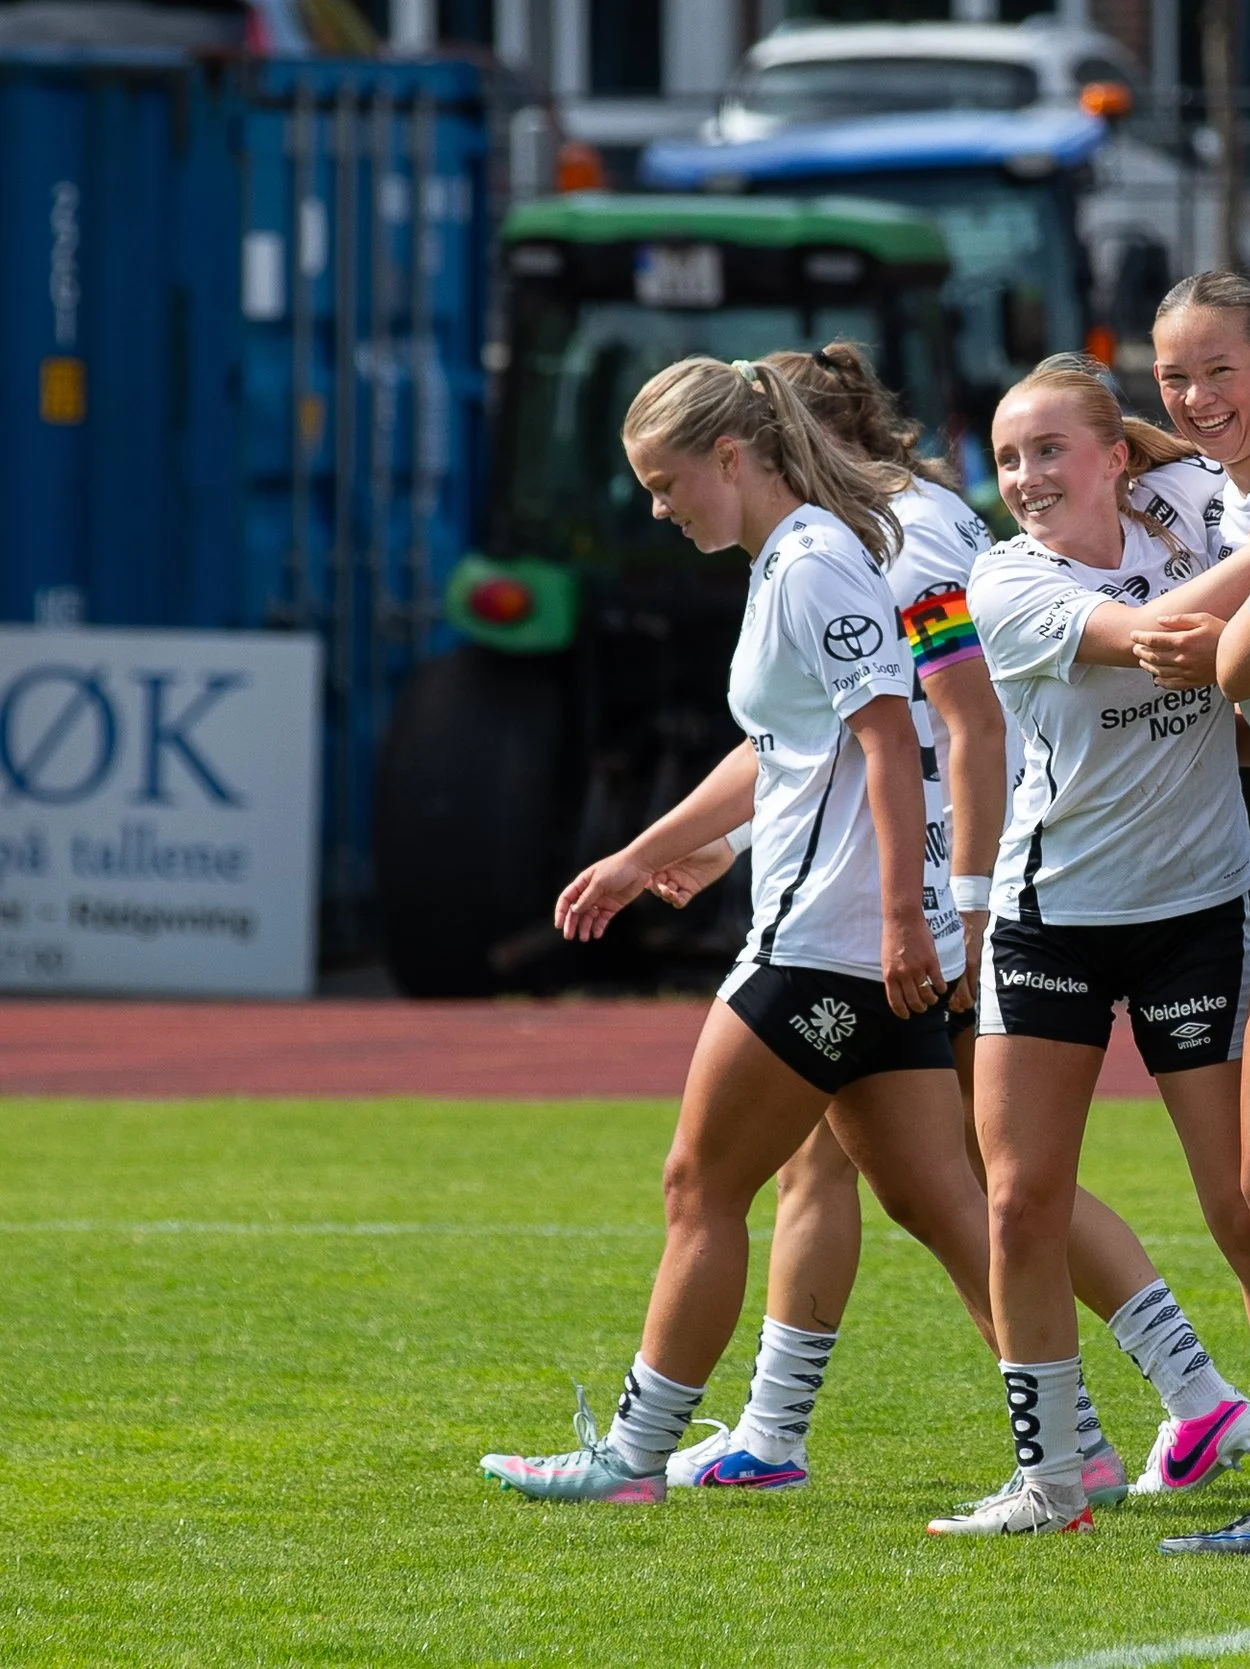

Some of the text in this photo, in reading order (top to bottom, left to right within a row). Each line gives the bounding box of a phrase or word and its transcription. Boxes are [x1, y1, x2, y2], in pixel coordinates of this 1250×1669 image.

[911, 604, 961, 662] C
[832, 662, 901, 692] Toyota Sogn
[999, 969, 1089, 994] Veidekke
[1140, 995, 1228, 1023] Veidekke
[789, 1014, 843, 1062] mesta
[1177, 1036, 1212, 1050] umbro
